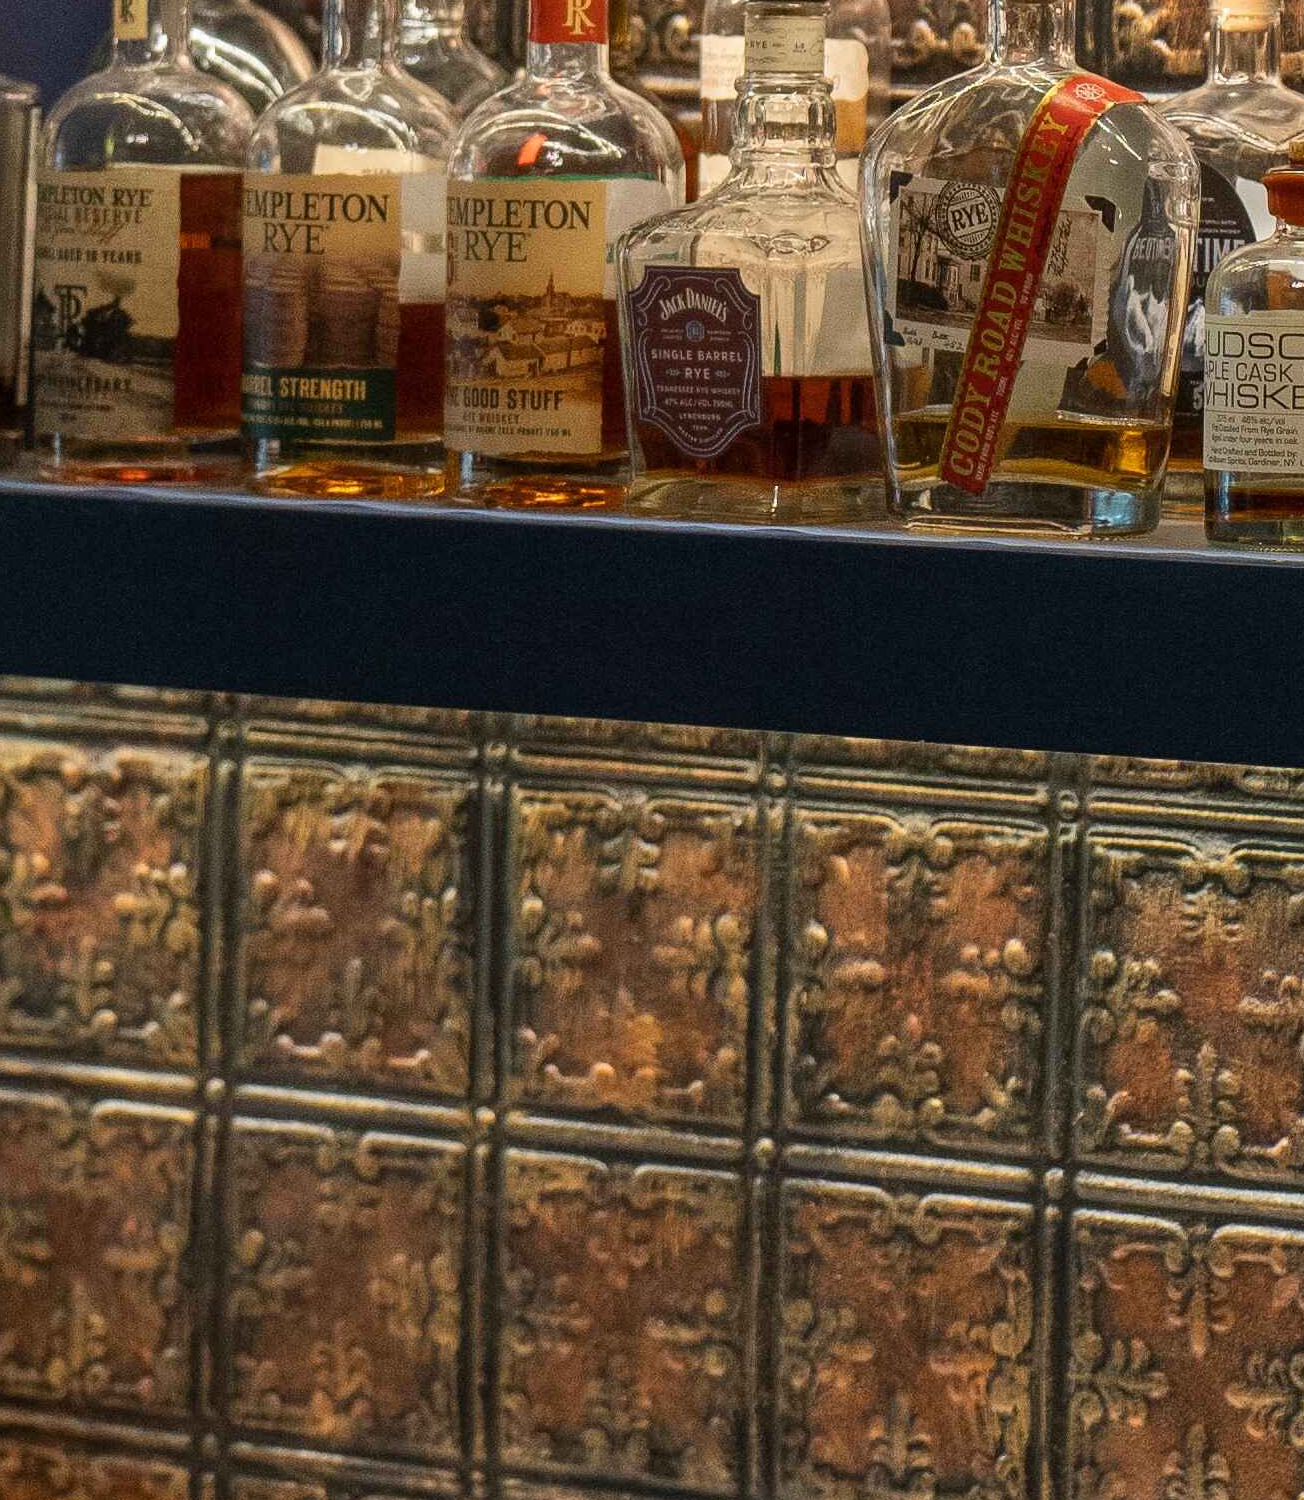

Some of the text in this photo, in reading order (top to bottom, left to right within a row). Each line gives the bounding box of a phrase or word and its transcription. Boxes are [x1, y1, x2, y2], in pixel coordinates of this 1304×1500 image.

[111, 187, 154, 207] RYE
[949, 202, 988, 235] RYE
[263, 222, 327, 256] RYE
[464, 231, 528, 263] RYE
[659, 287, 729, 323] JACK DANIEL'S
[949, 384, 986, 479] CODY
[974, 278, 1020, 377] ROAD
[998, 110, 1071, 277] WHISKEY
[651, 348, 744, 363] SINGLE BARREL
[684, 367, 713, 380] RYE
[1235, 362, 1295, 384] CASK
[279, 376, 367, 401] STRENGTH
[462, 386, 565, 411] GOOD STUFF
[1260, 426, 1276, 437] Rye
[1257, 448, 1285, 458] Bottled
